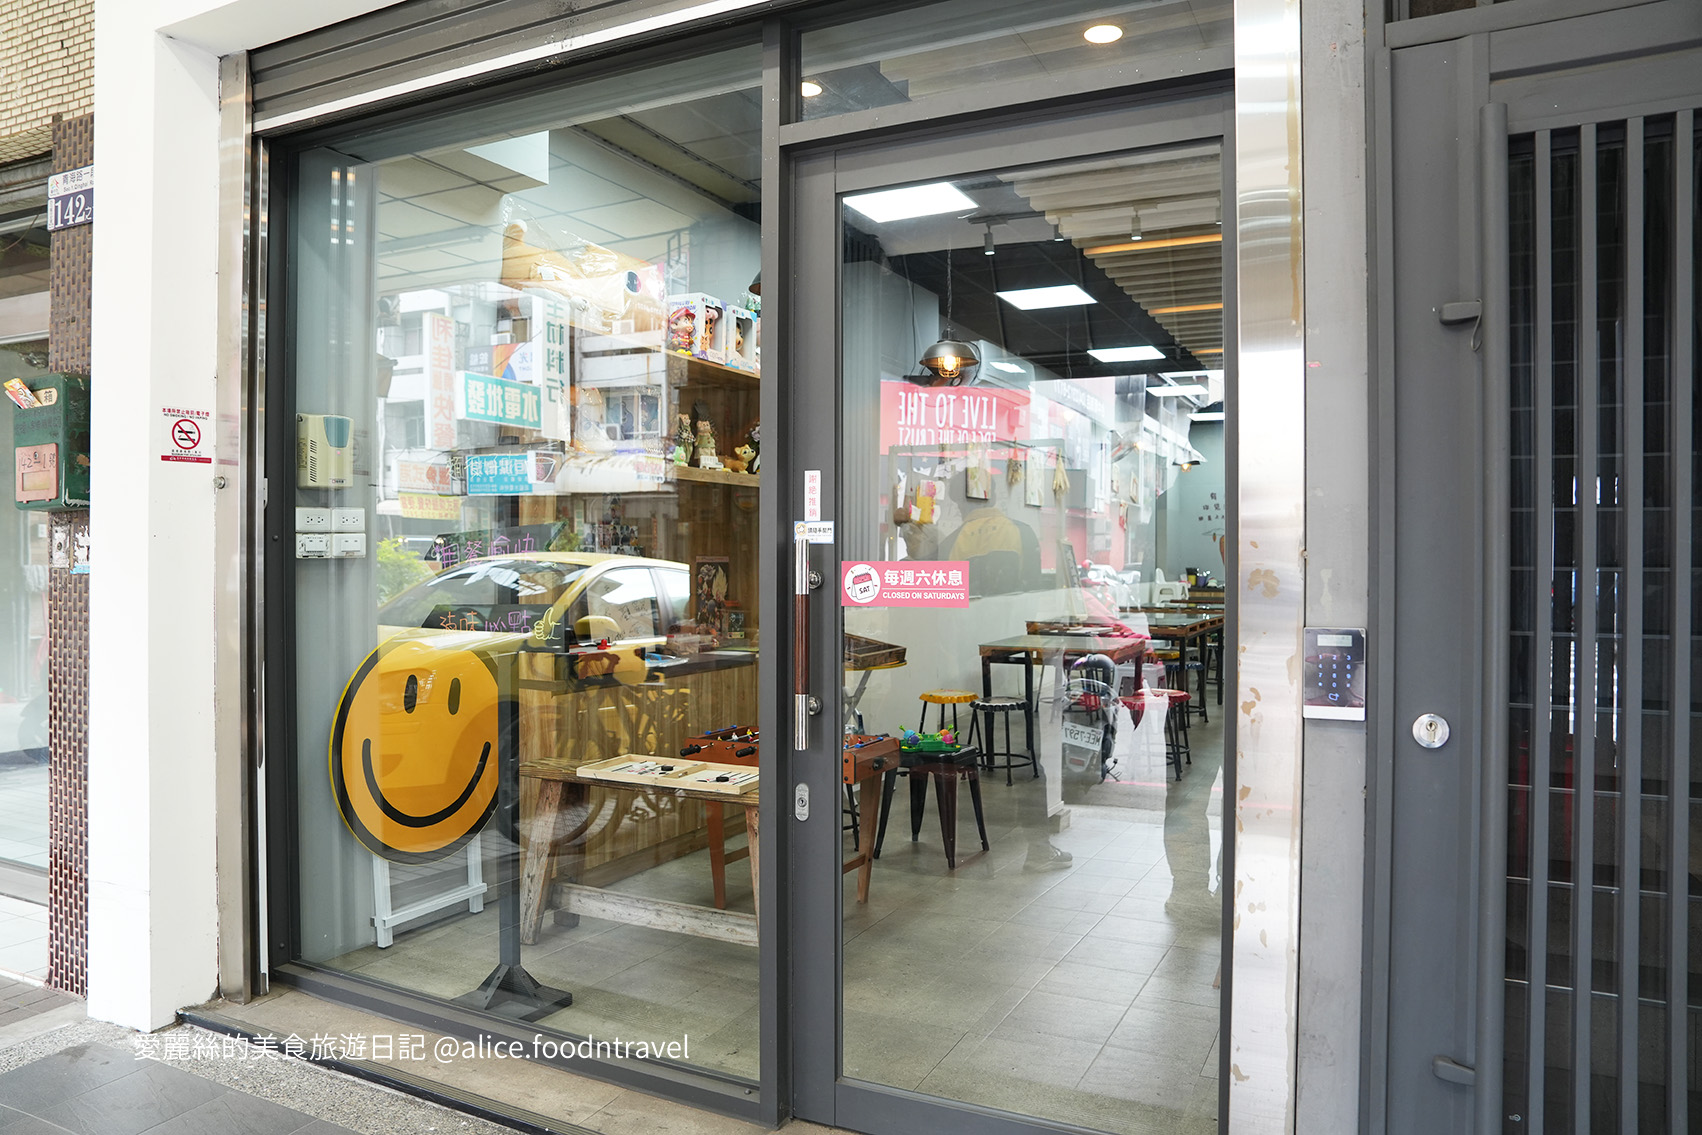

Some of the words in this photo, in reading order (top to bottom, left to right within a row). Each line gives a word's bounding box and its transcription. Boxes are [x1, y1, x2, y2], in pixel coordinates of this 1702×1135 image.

[884, 570, 963, 586] 每週六休息
[859, 586, 870, 594] SAT
[882, 592, 910, 600] CLOSED
[923, 592, 965, 600] SATURDAYS
